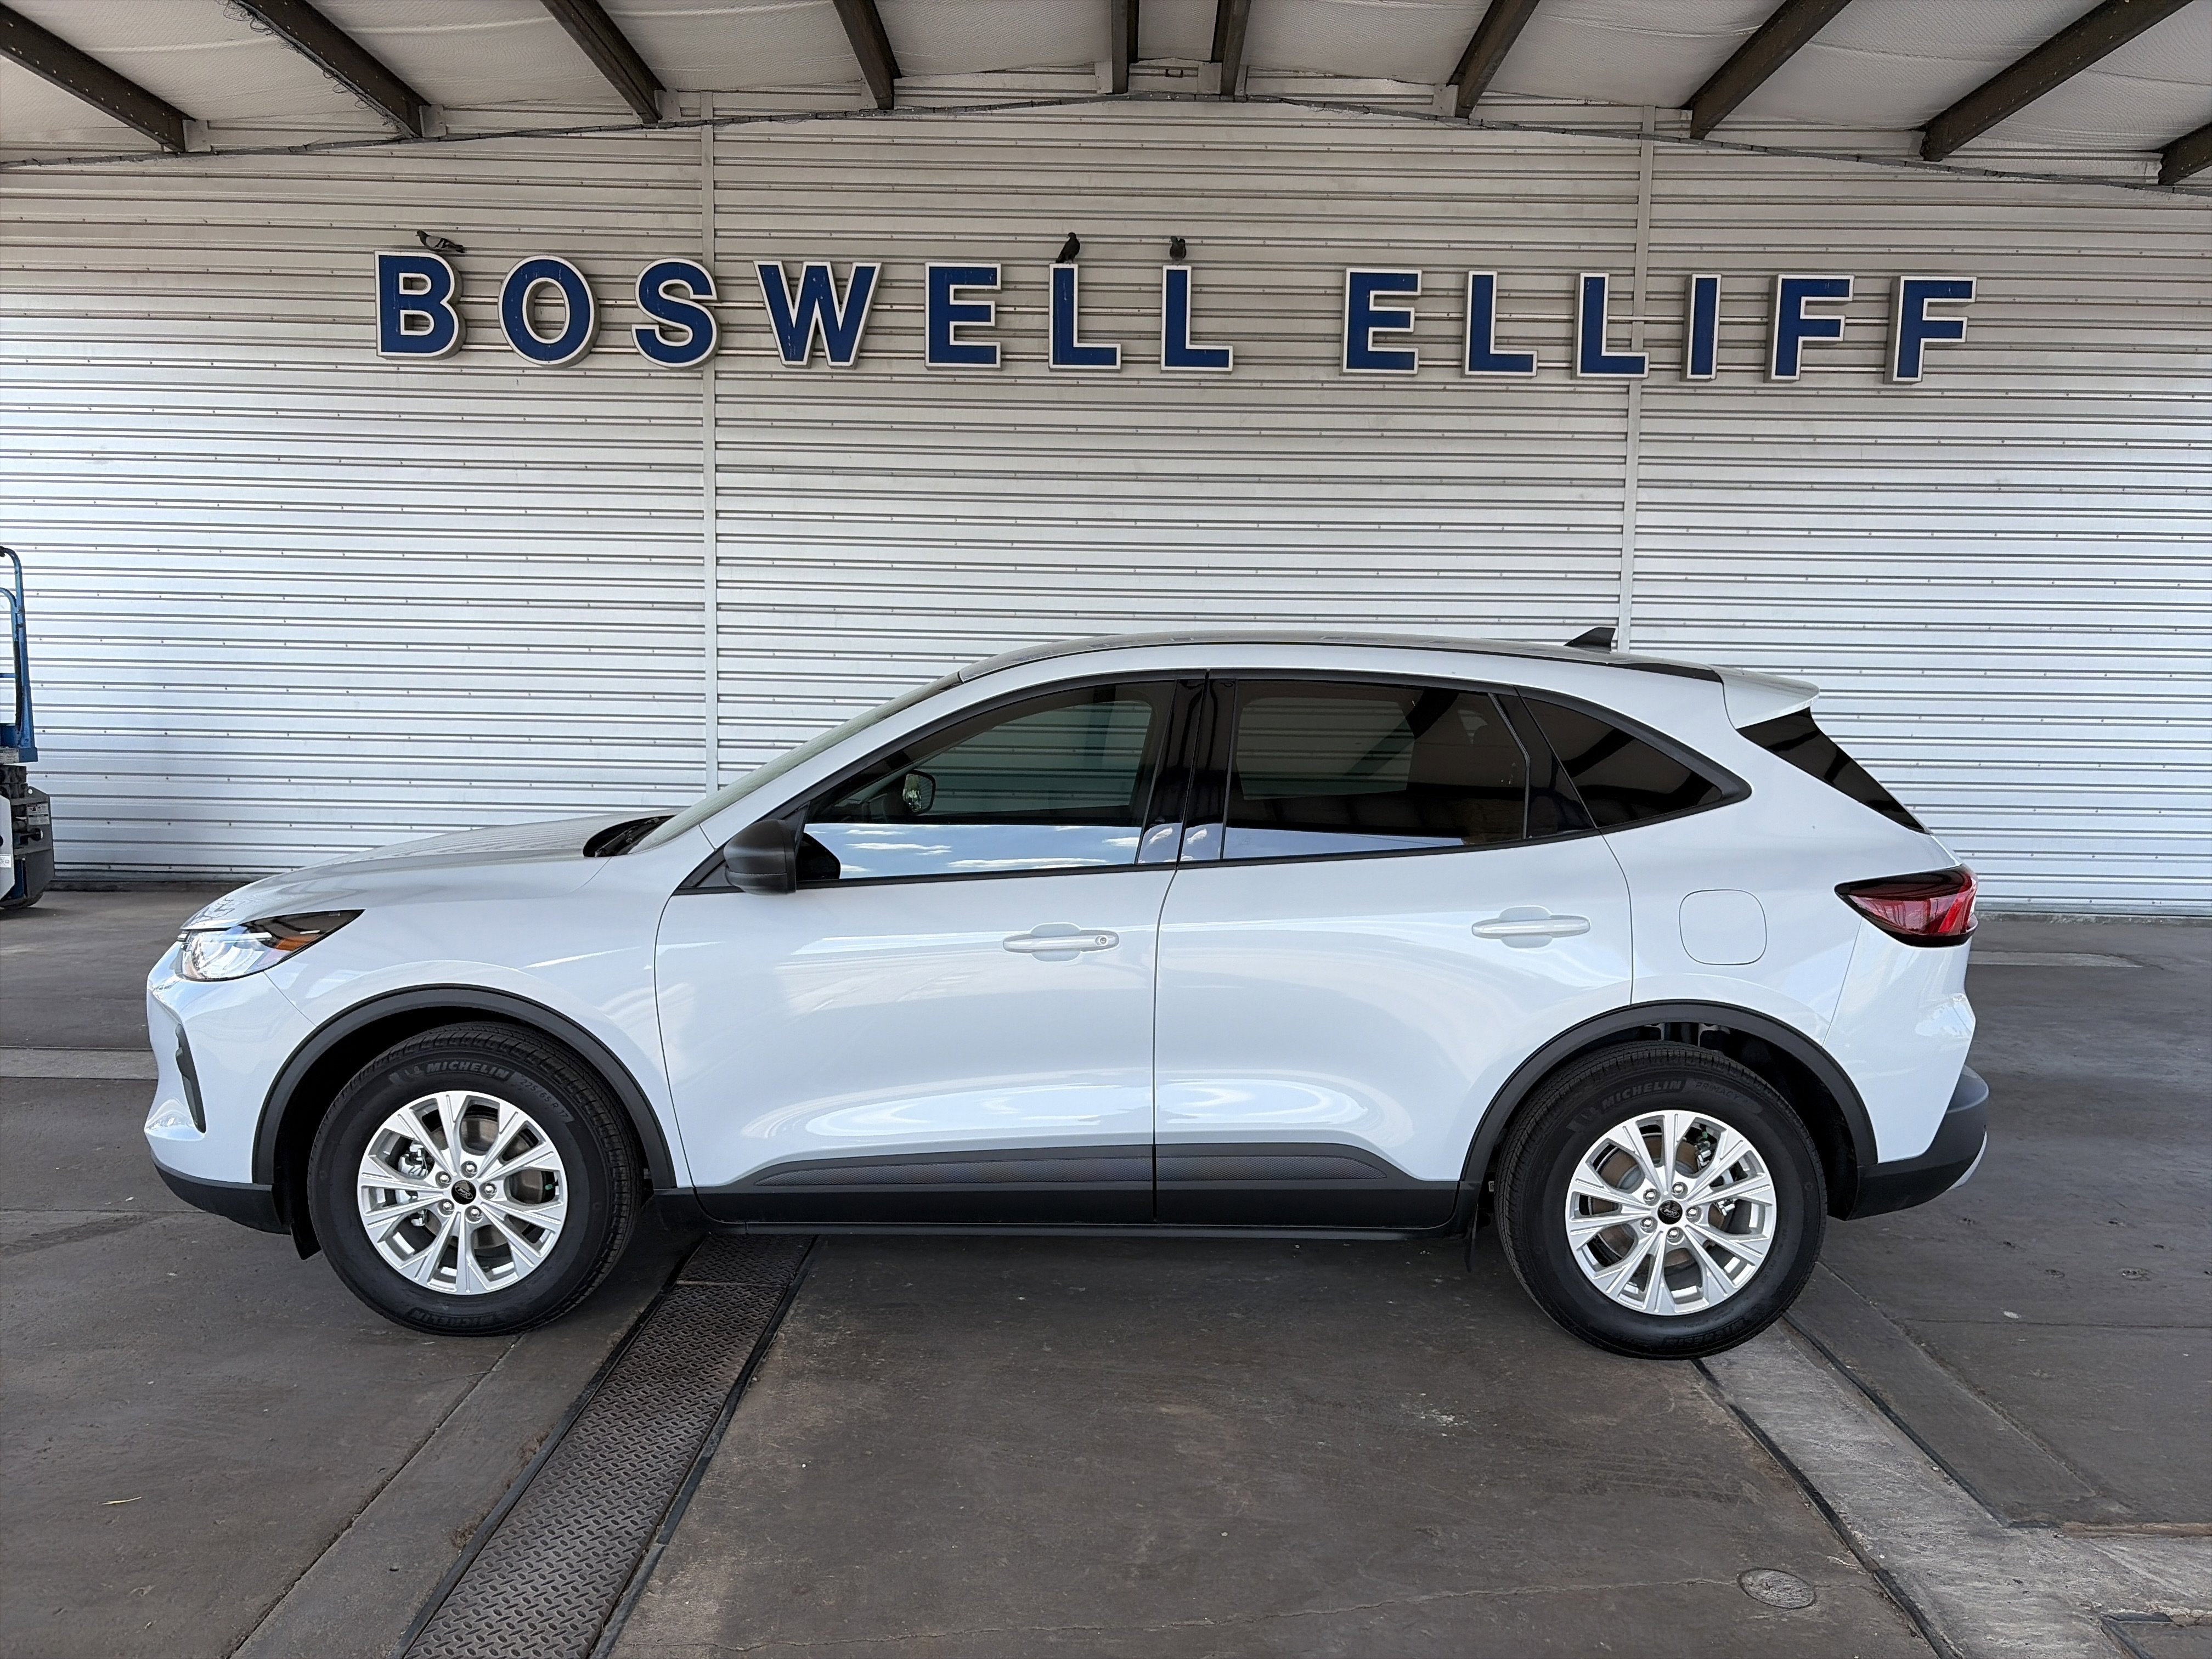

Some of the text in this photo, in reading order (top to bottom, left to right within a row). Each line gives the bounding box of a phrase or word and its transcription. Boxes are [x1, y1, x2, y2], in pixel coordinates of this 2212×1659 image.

[374, 250, 1977, 382] BOSWELL ELLIFF
[426, 1061, 510, 1080] MICHELIN
[521, 1079, 552, 1102] 225/65
[1602, 1080, 1681, 1109] MICHELIN
[1695, 1081, 1741, 1100] PRIMACY
